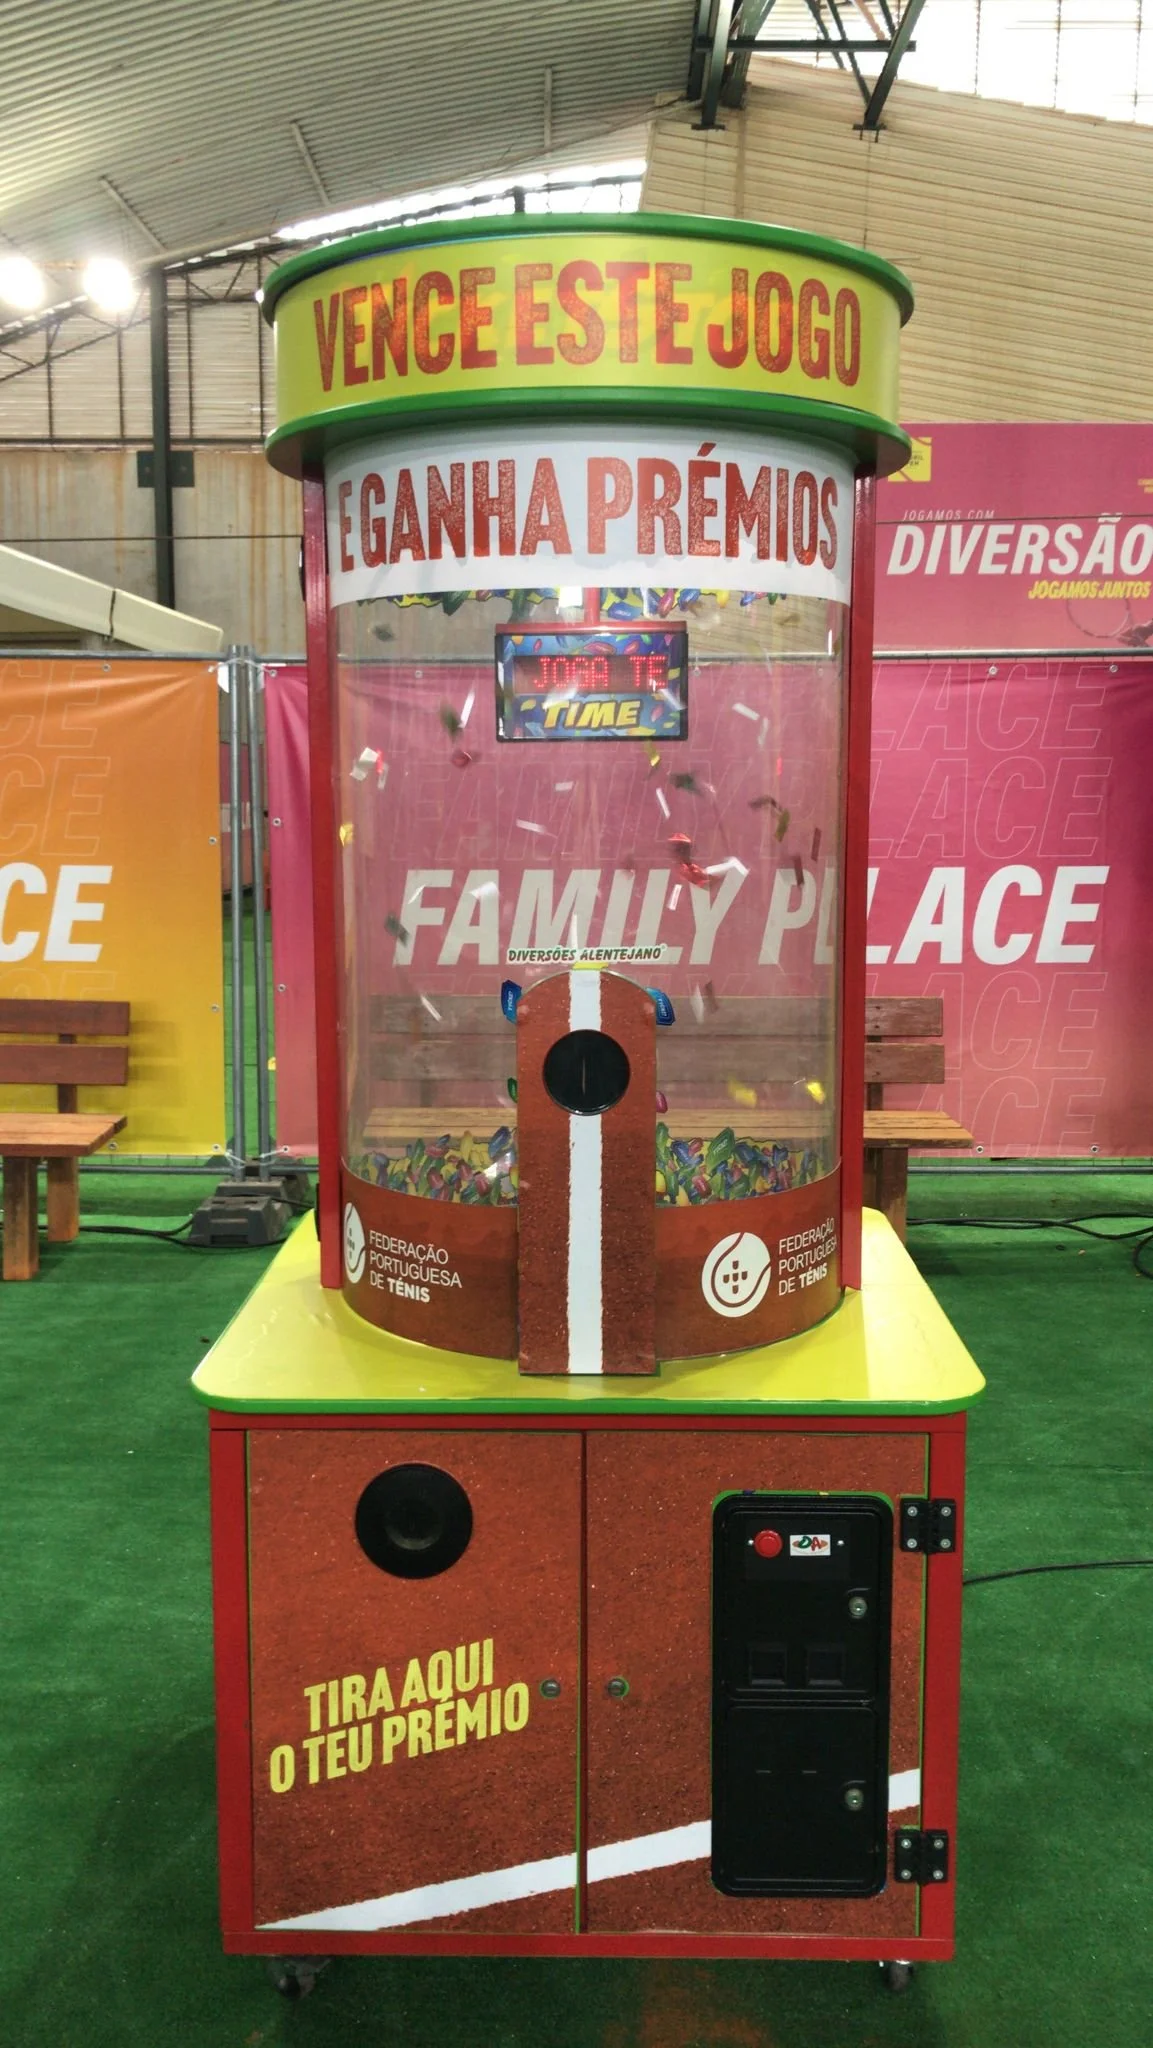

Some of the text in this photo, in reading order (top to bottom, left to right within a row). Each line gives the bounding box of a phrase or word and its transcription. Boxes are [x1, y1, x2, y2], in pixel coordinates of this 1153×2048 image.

[313, 259, 861, 392] VENCE ESTE JOGO
[338, 443, 839, 573] E GANHA PRÉMIOS
[902, 509, 995, 521] JOGAMOS COM
[887, 513, 1153, 576] DIVERSÃO
[1028, 580, 1152, 599] JOGAMOS JUNTOS
[541, 699, 642, 729] TIME
[393, 868, 749, 967] FAMILY
[508, 946, 662, 962] DIVERSÕES ALENTEJANO
[369, 1229, 449, 1264] FEDERAÇÃO
[779, 1217, 835, 1255] FEDERAÇÃO
[369, 1250, 463, 1288] PORTUGUESA
[370, 1270, 431, 1303] DE TÉNIS
[778, 1262, 828, 1296] DE TÉNIS
[304, 1638, 494, 1732] TIRA AQUI
[270, 1682, 529, 1793] O TEU PRÉMIO
